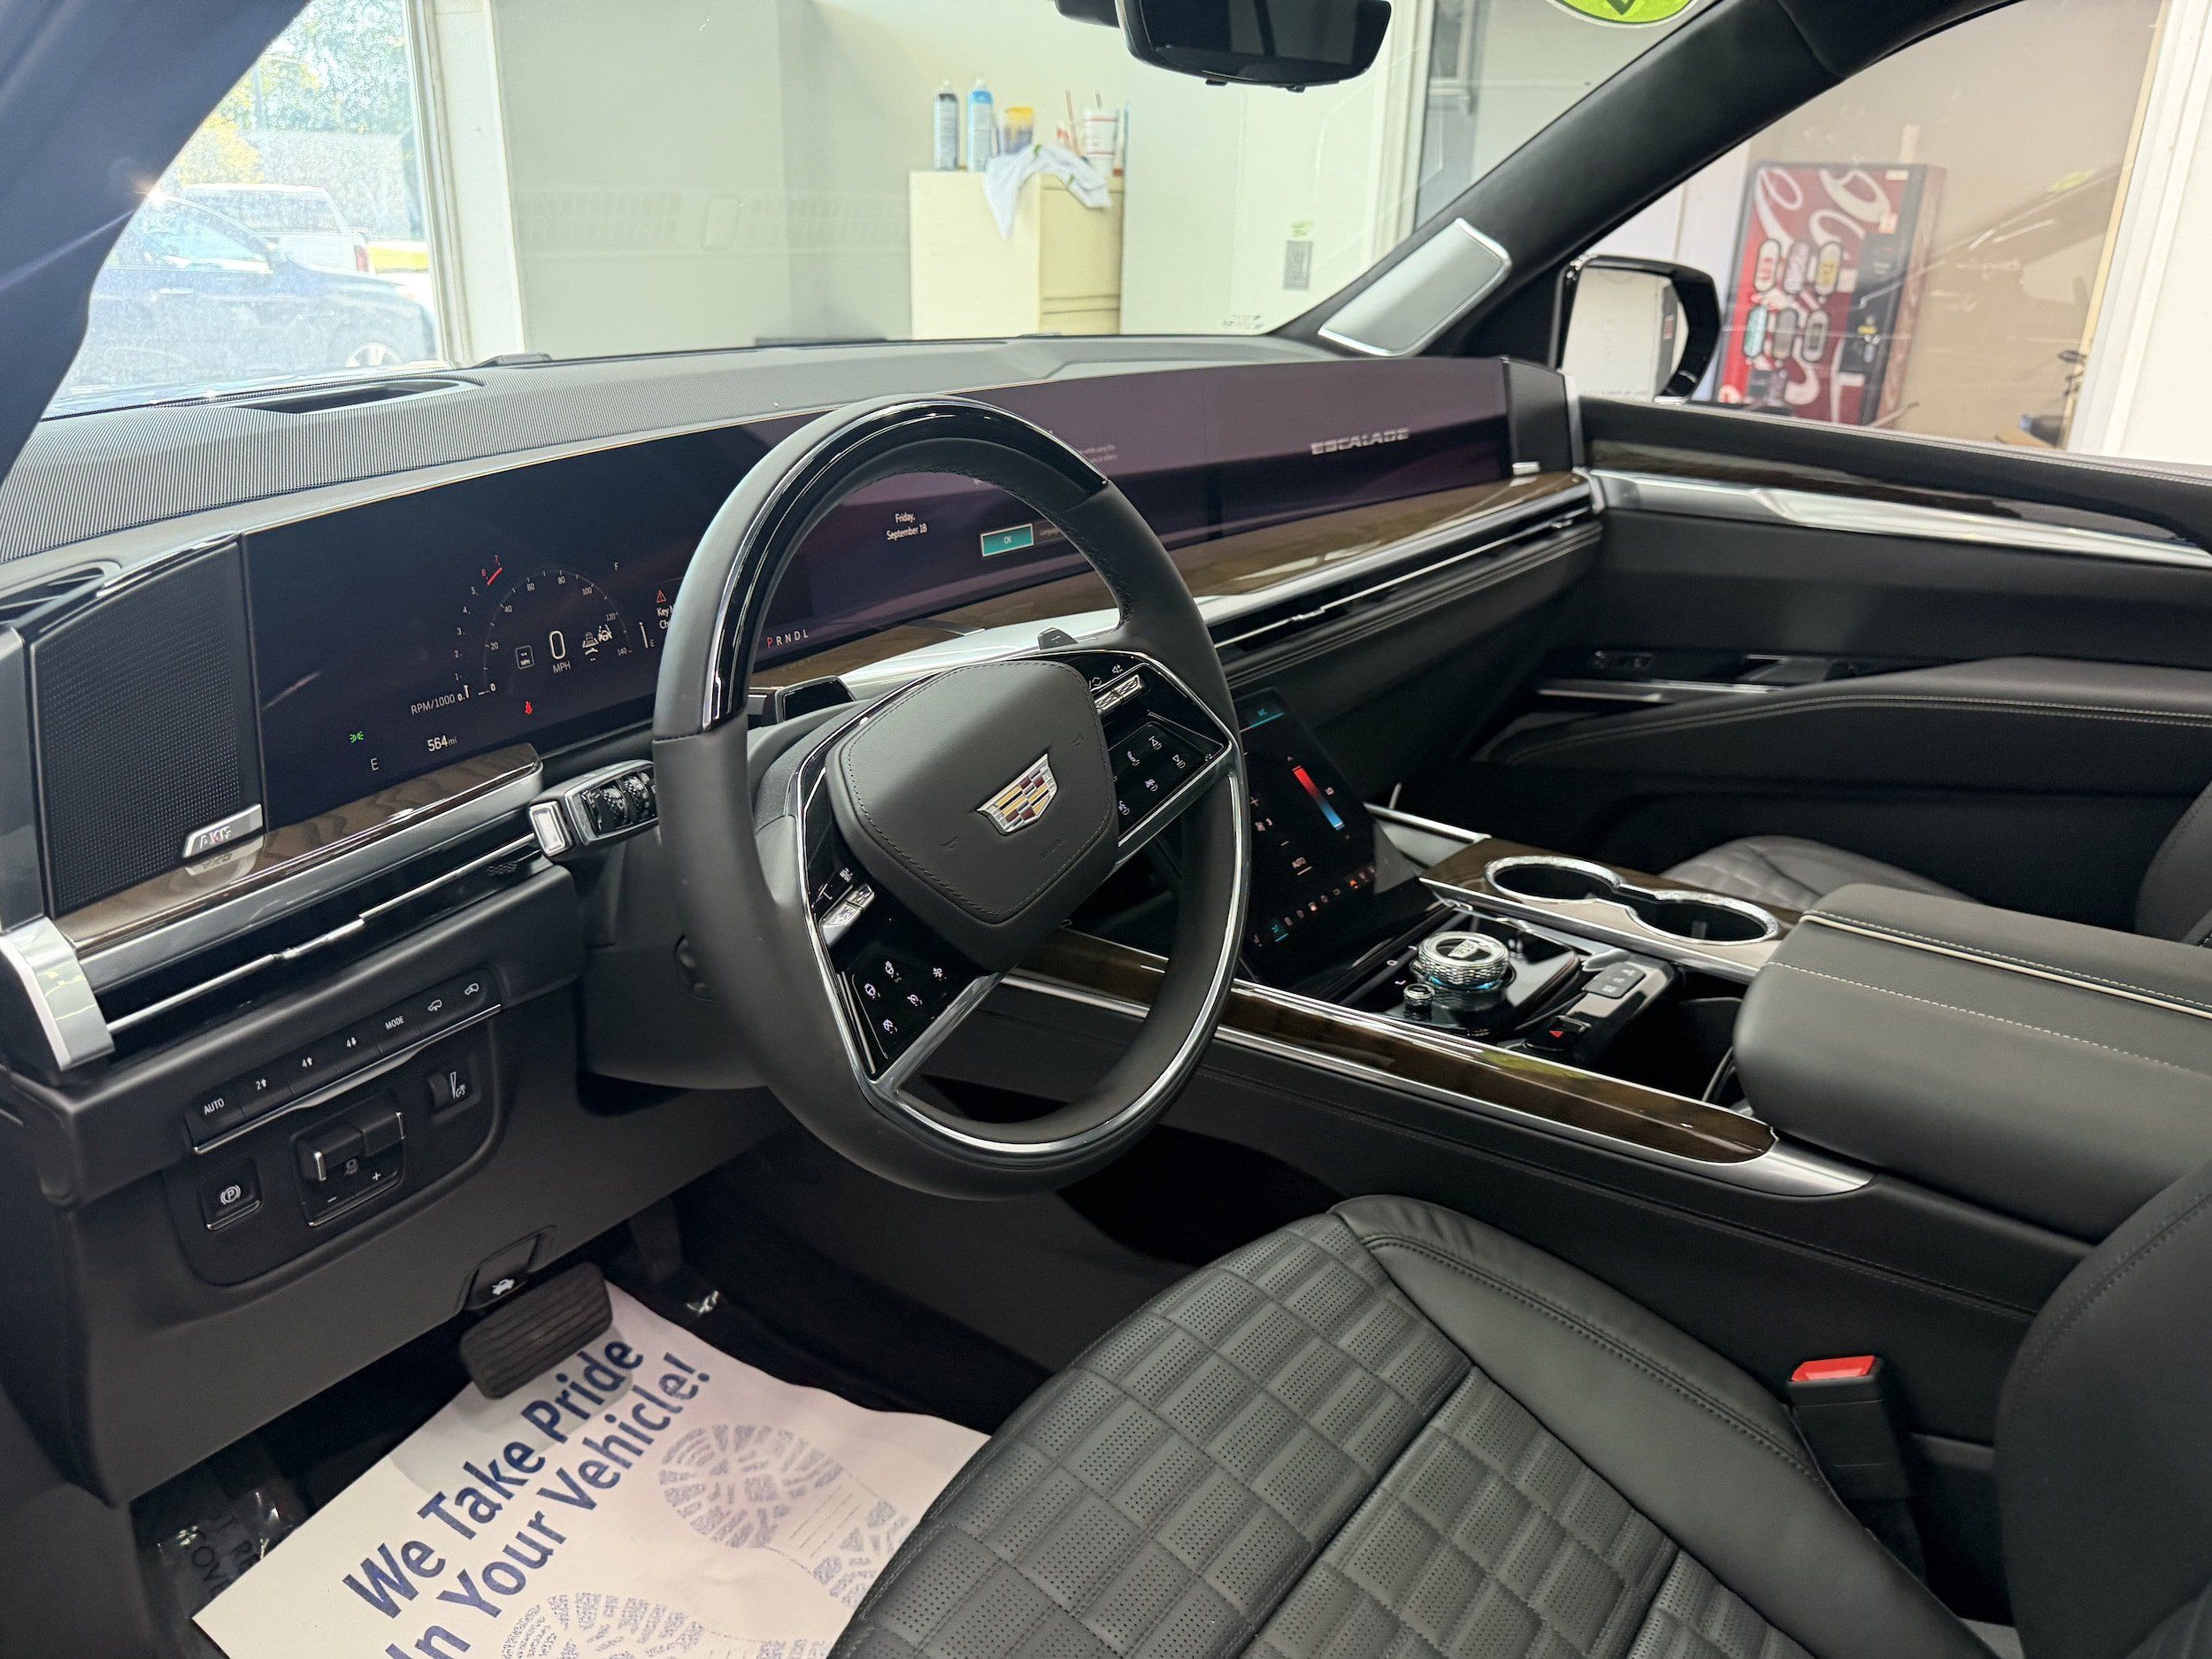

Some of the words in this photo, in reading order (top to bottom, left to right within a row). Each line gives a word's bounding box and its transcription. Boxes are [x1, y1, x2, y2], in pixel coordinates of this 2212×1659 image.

[886, 526, 918, 541] September
[526, 582, 535, 592] 60
[557, 576, 566, 585] 80
[581, 587, 593, 596] 100
[503, 604, 513, 613] 40
[657, 606, 670, 618] Key
[605, 612, 616, 622] 120
[490, 641, 499, 651] 20
[549, 630, 566, 660] 0
[552, 660, 572, 674] MPH
[410, 694, 456, 715] RPM/1000
[426, 734, 448, 752] 564
[370, 757, 380, 772] E
[385, 1015, 405, 1032] MODE
[204, 1097, 226, 1117] AUTO
[342, 1540, 446, 1619] We
[417, 1441, 546, 1540] Take
[520, 1340, 644, 1444] Pride
[436, 1510, 567, 1618] Your
[536, 1352, 710, 1511] Vehicle!
